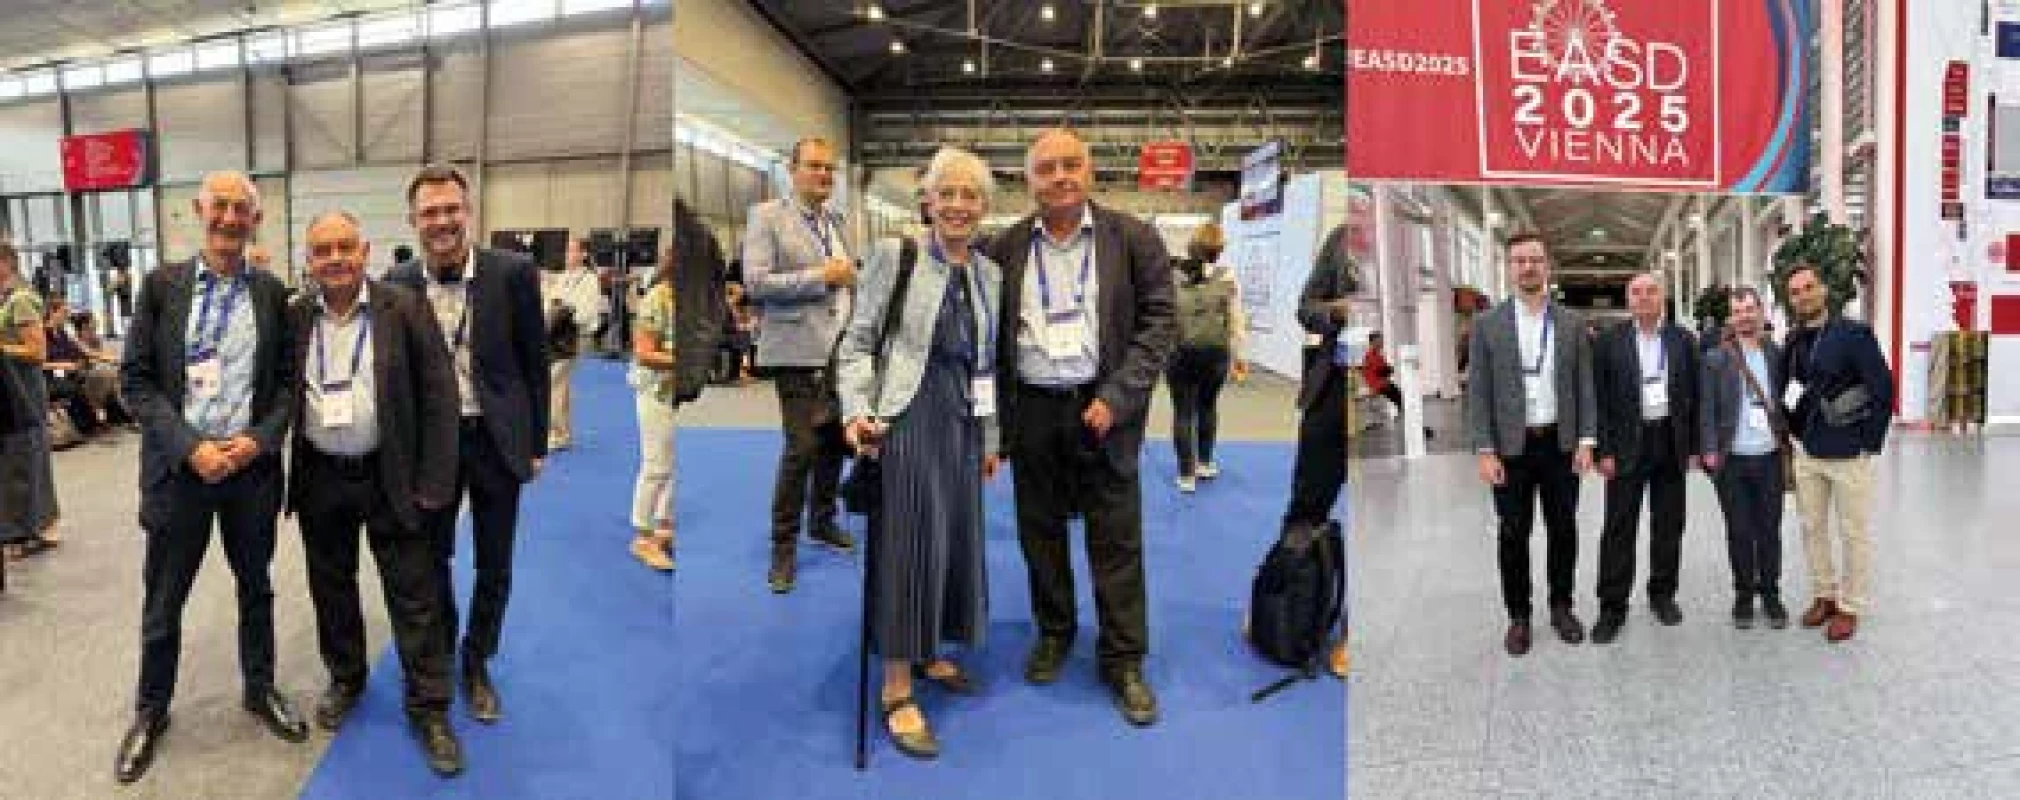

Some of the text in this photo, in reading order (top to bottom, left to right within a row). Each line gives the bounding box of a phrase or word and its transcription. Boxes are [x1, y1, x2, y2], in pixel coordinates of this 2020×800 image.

[1510, 30, 1688, 90] EASD
[1512, 85, 1690, 132] 2025
[1514, 127, 1690, 166] VIENNA
